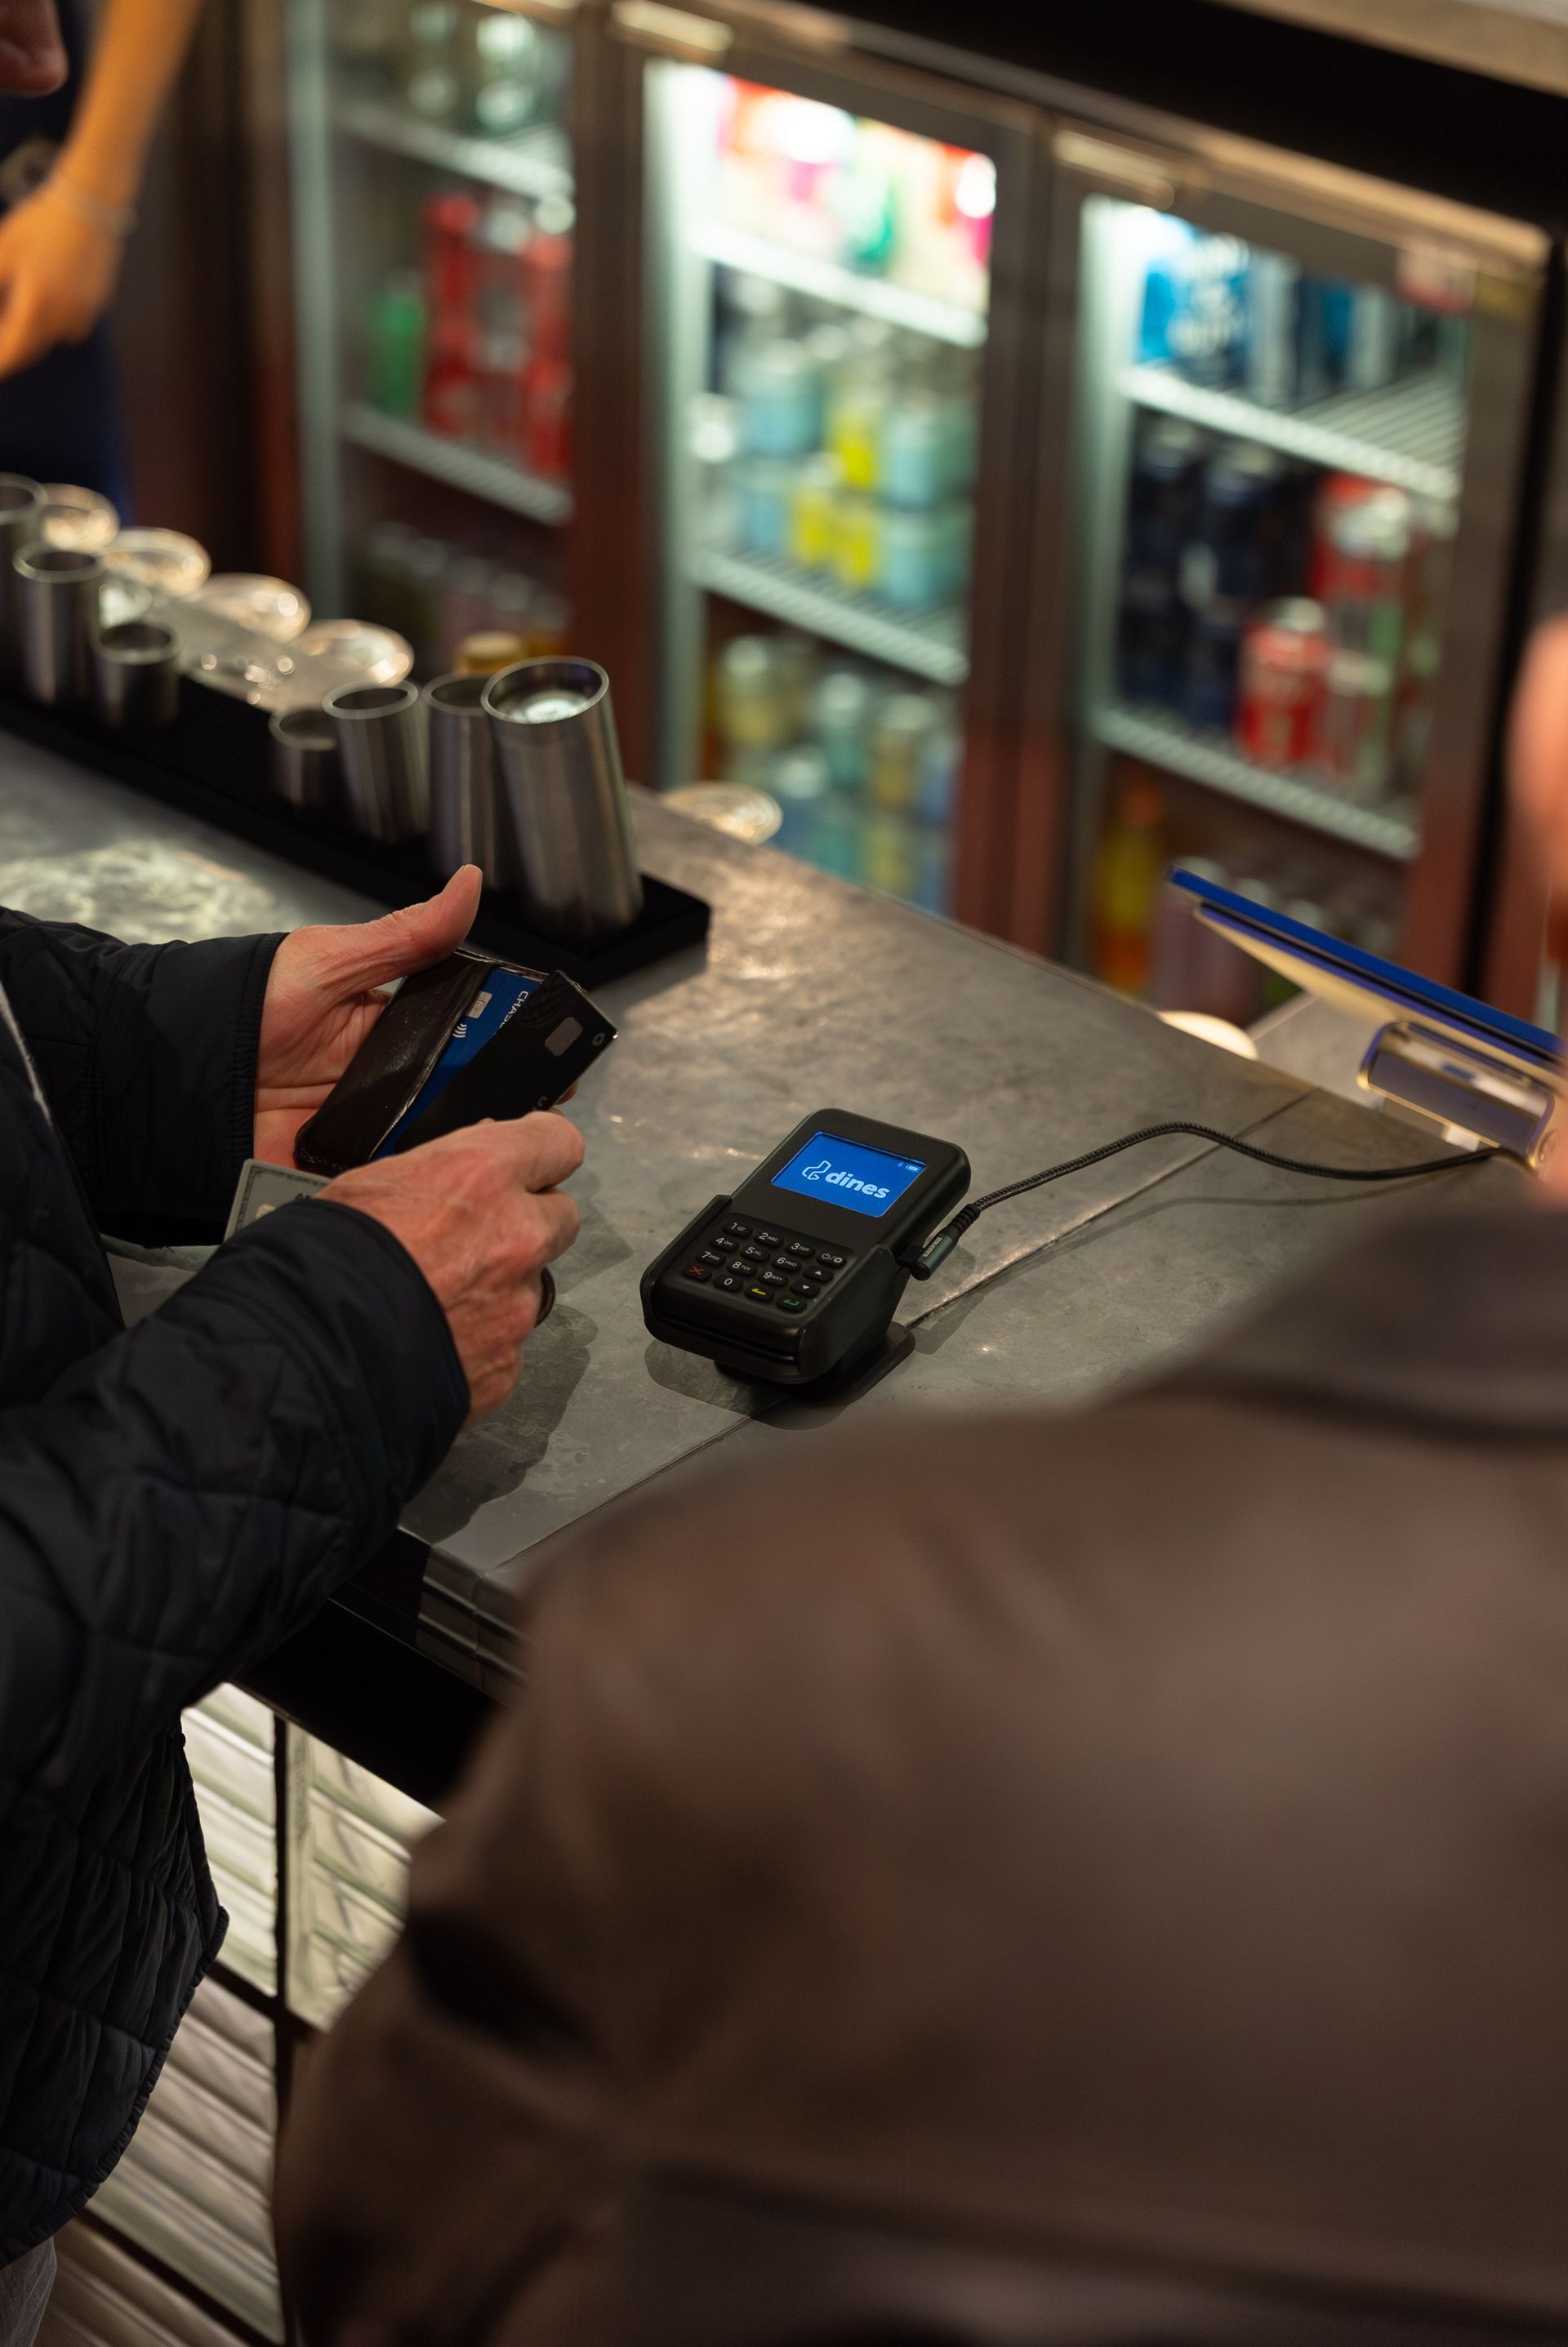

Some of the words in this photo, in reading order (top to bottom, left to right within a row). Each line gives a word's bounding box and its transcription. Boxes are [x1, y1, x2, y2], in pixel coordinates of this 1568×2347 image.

[499, 991, 528, 1029] CHAS
[825, 1171, 890, 1199] dines
[759, 1232, 768, 1240] 2
[724, 1277, 733, 1285] 0
